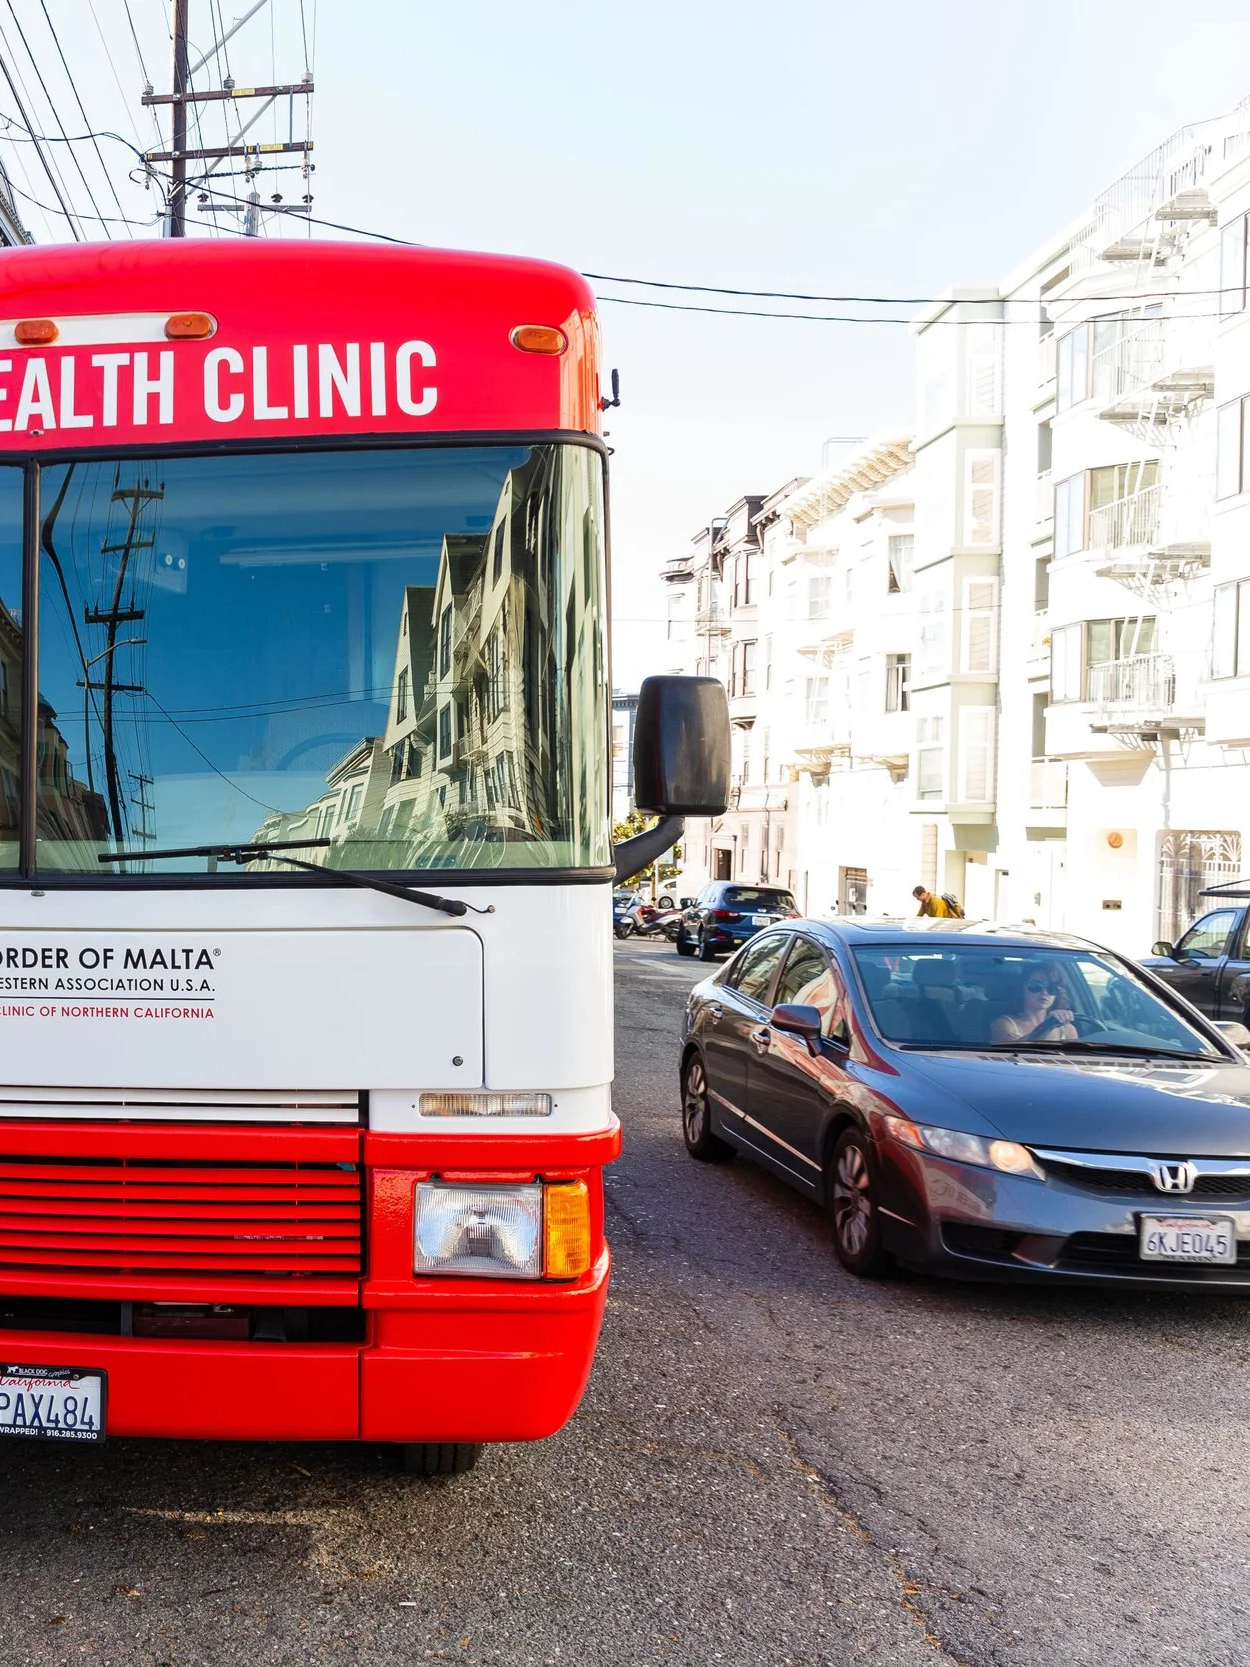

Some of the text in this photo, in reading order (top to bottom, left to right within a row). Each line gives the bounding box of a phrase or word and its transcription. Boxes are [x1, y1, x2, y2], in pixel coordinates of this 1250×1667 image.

[203, 340, 438, 423] CLINIC
[78, 947, 114, 970] OF
[54, 977, 164, 992] ASSOCIATION
[169, 978, 216, 992] U.S.A.
[39, 1005, 57, 1018] OF
[61, 1006, 130, 1019] NORTHERN
[133, 1006, 215, 1020] CALIFORNIA
[1146, 1231, 1228, 1256] 6KJE045
[36, 1368, 48, 1376] DOG
[0, 1375, 80, 1392] California
